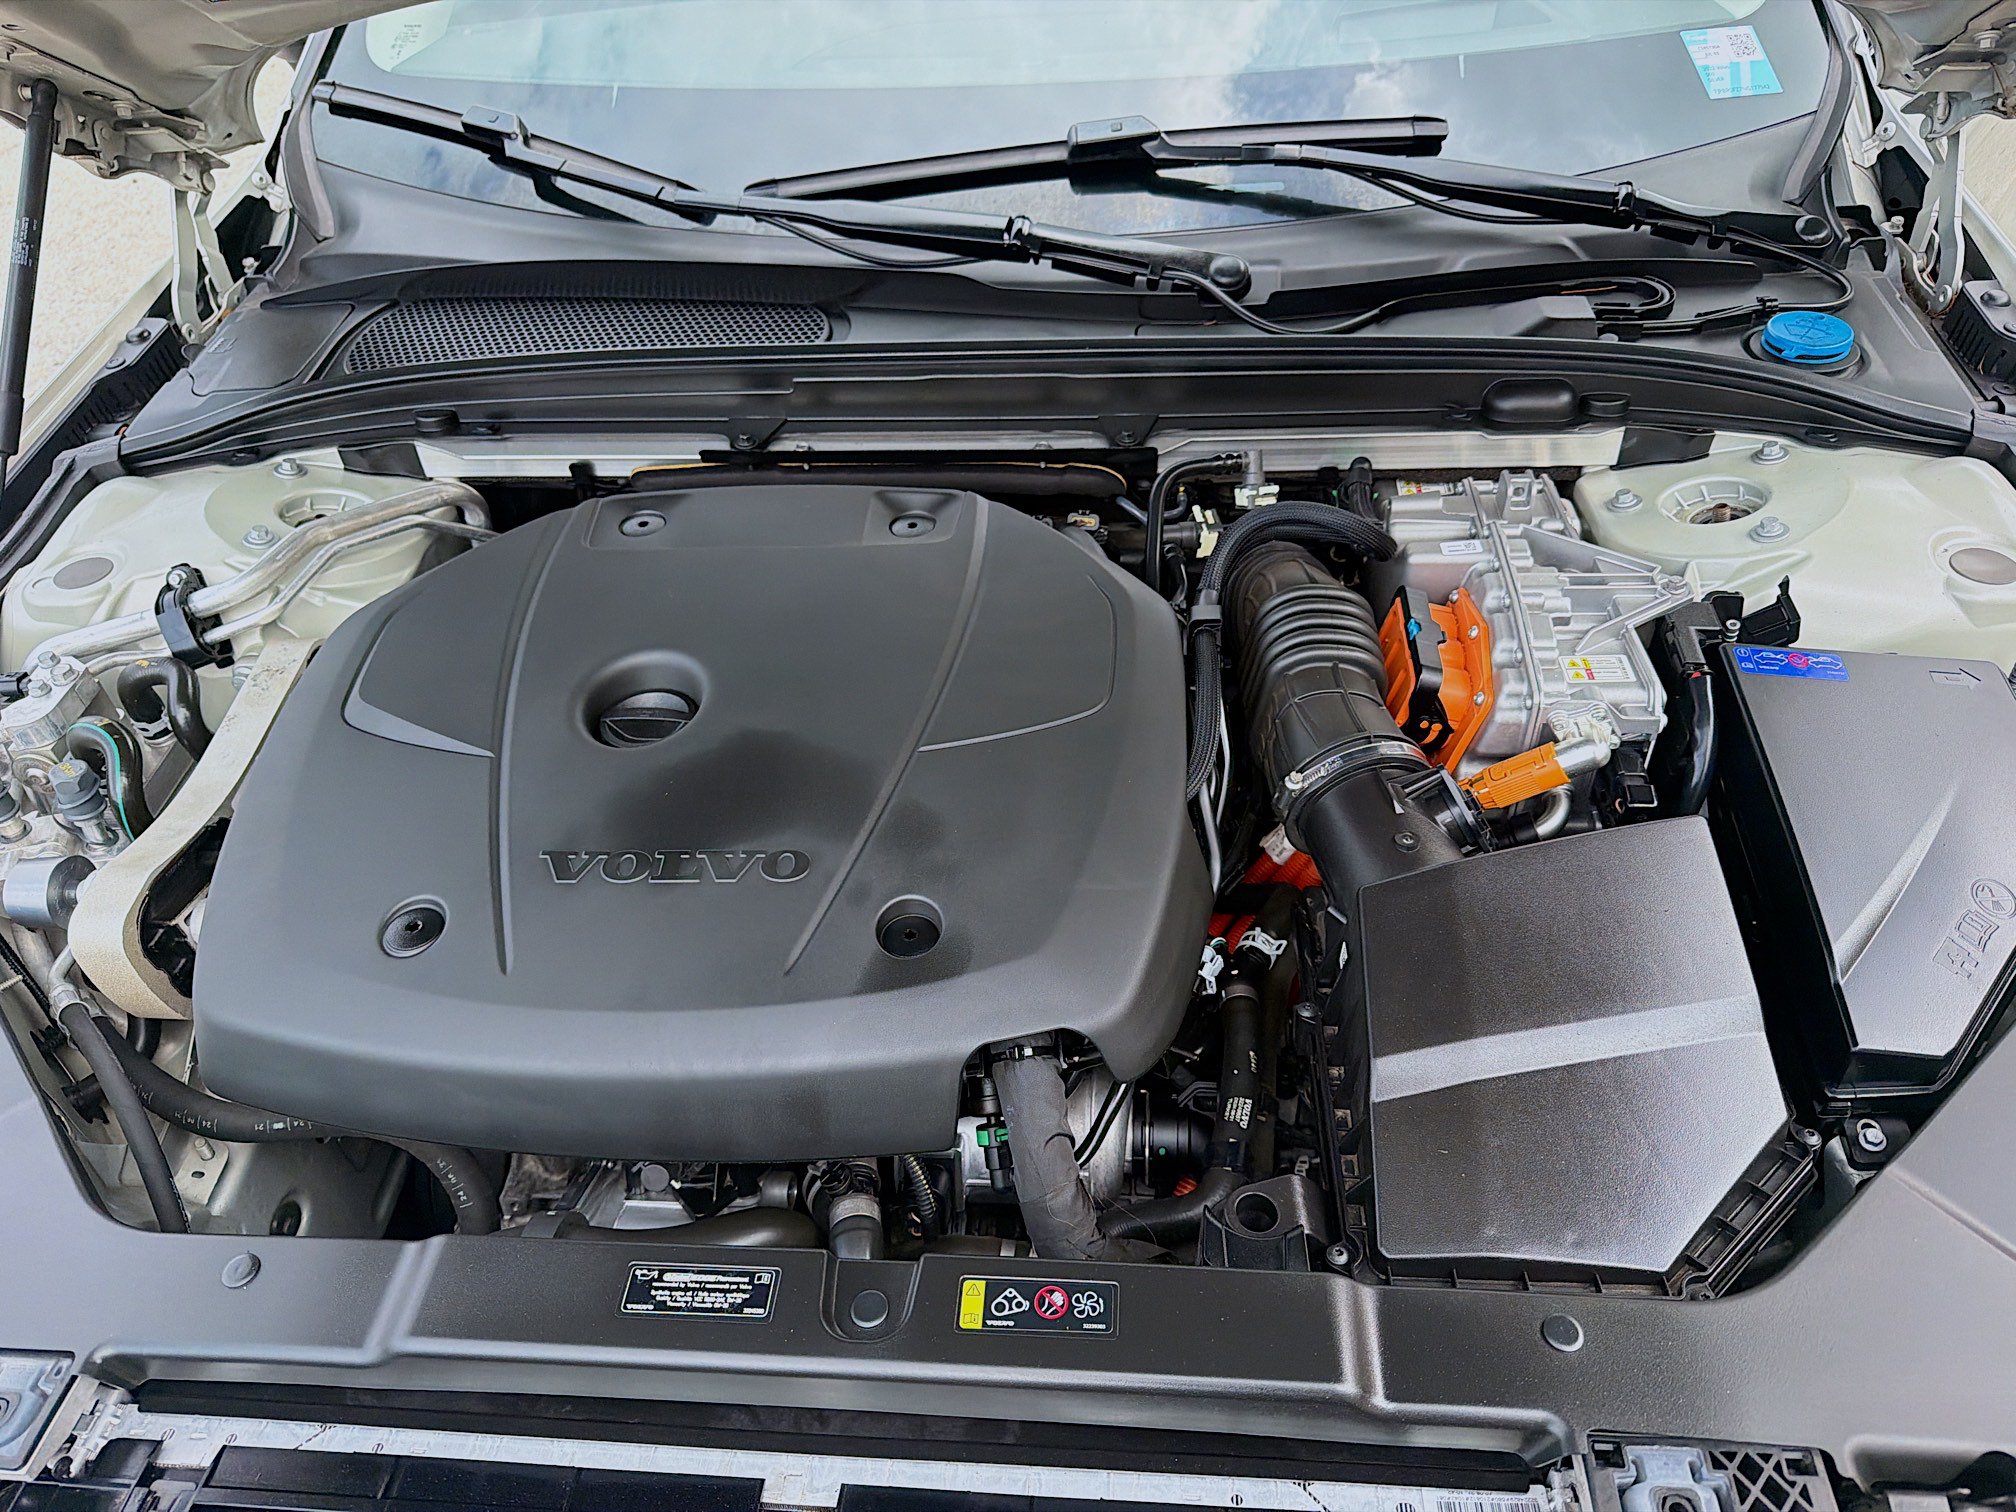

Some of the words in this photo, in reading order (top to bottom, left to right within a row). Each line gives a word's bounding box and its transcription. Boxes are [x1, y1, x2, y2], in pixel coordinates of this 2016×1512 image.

[538, 849, 812, 884] VOLVO
[1223, 1097, 1234, 1122] TURKEY
[1239, 1098, 1253, 1130] VOLVO
